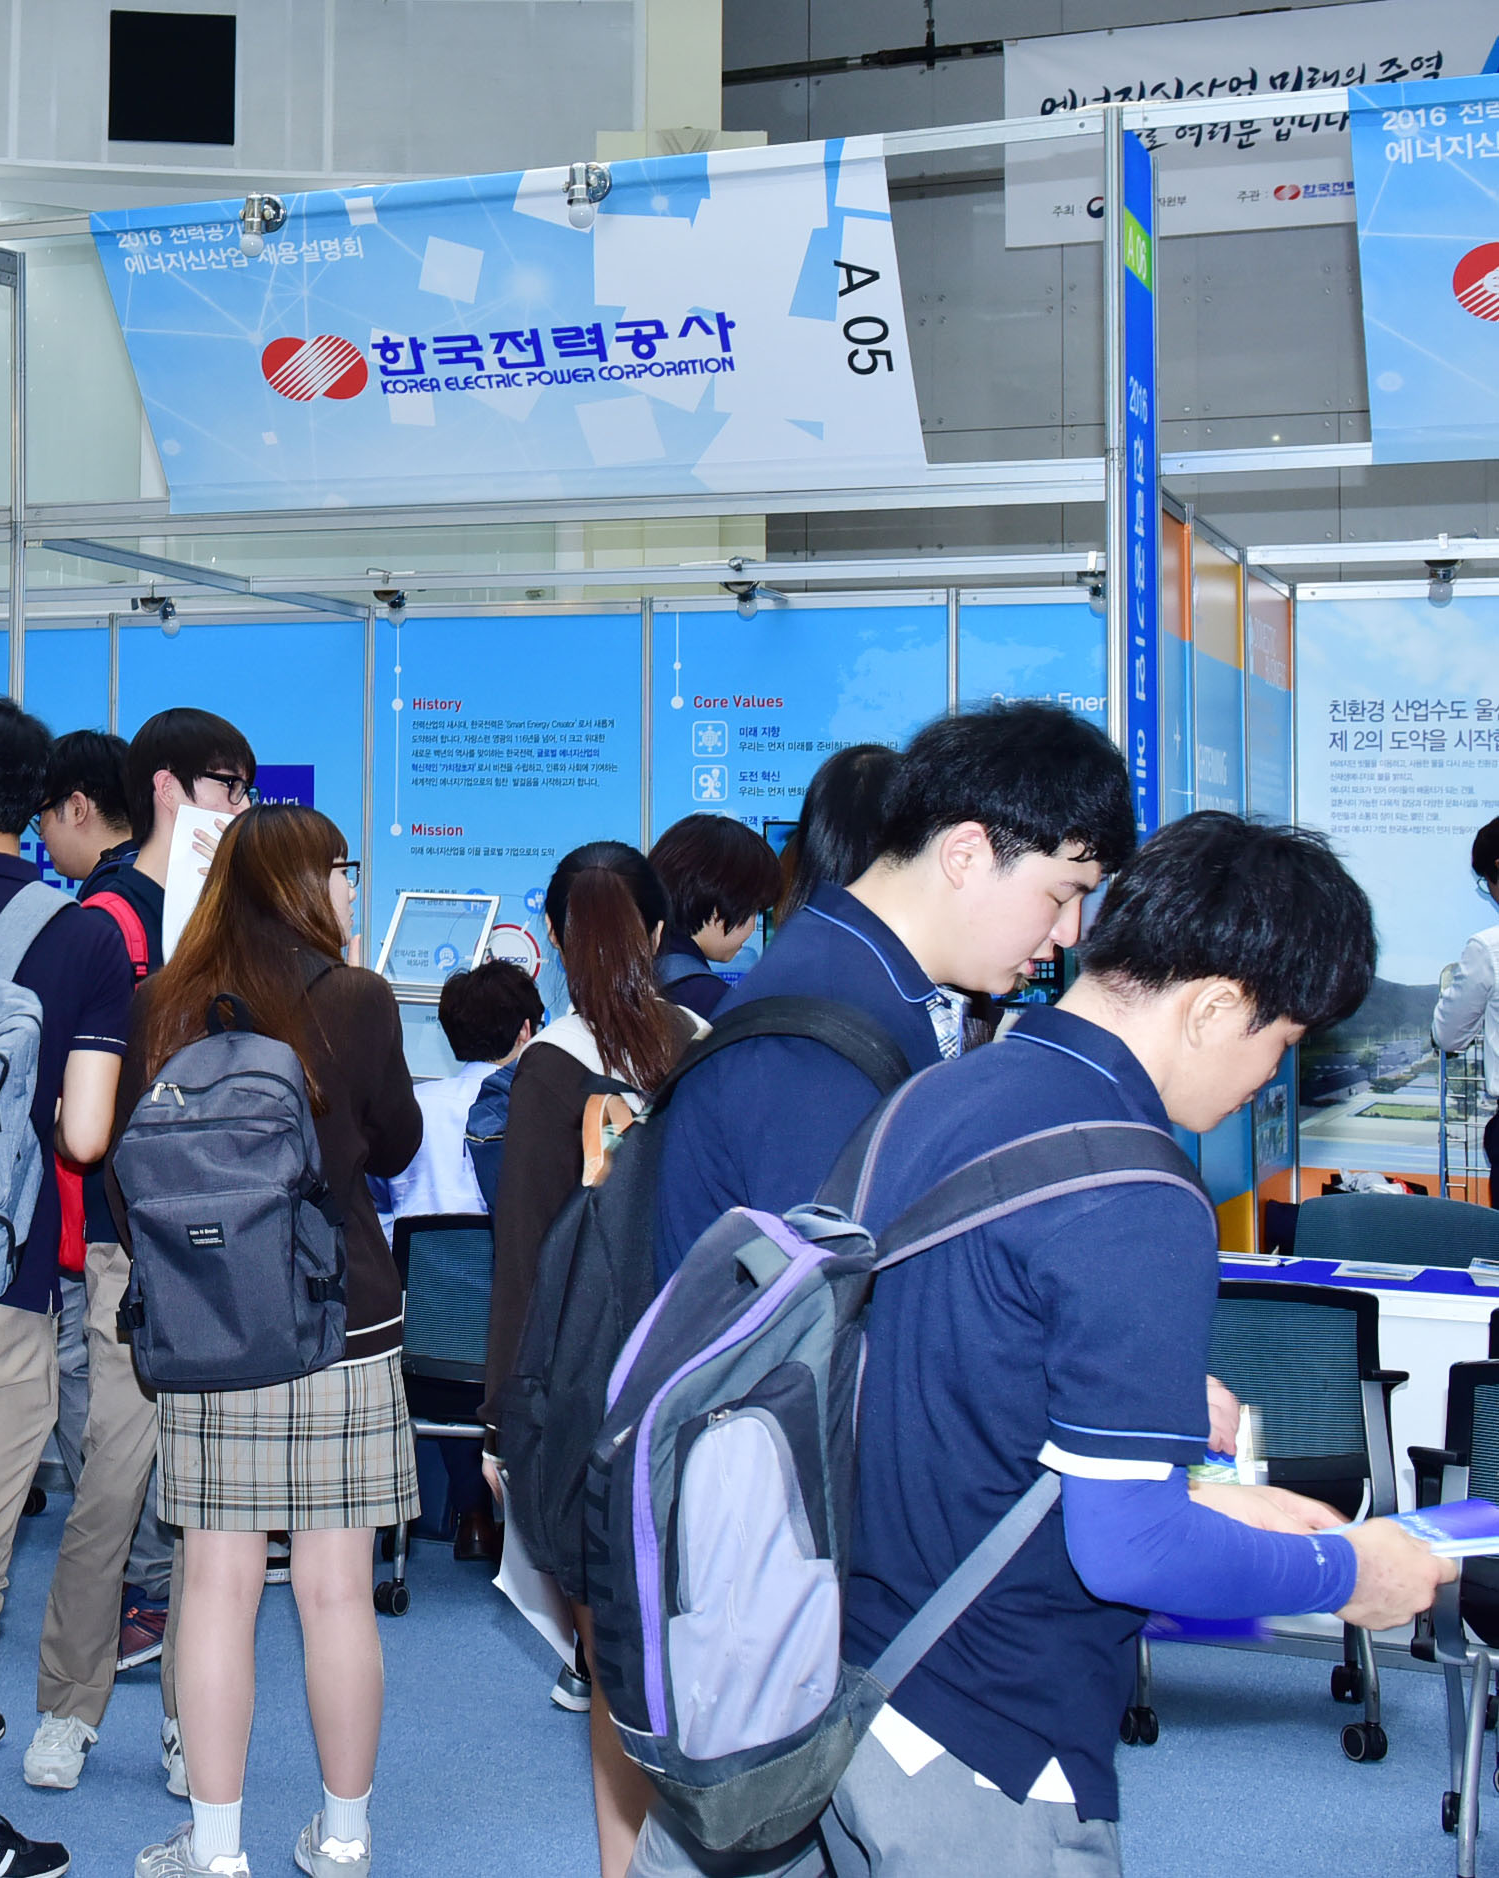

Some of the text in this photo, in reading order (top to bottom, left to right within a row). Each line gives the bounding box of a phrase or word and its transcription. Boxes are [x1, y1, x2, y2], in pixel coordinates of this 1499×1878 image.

[1269, 62, 1365, 91] 미래의
[1375, 50, 1443, 83] 주역
[1382, 106, 1447, 131] 2016
[116, 221, 245, 249] 2016 전력공기
[124, 236, 364, 275] 에너지신산업 채용설명회
[1127, 225, 1147, 280] A 06
[833, 259, 895, 377] A 05
[371, 310, 737, 377] 한국전력공사
[380, 355, 737, 396] KOREA ELECTRIC POWER CORPORATION
[1129, 375, 1148, 424] 2016
[412, 698, 462, 712] History
[693, 695, 784, 709] Core Values
[1328, 698, 1499, 723] 친환경 산업수도 울
[527, 720, 550, 730] Energy
[739, 726, 781, 738] 미래 지향
[739, 741, 764, 752] 우리는
[768, 741, 785, 752] 먼저
[788, 741, 814, 752] 미래를
[1328, 729, 1348, 752] 제
[1353, 729, 1383, 752] 2의
[1389, 729, 1448, 752] 도약을
[739, 771, 781, 782] 도전 혁신
[739, 786, 764, 797] 우리는
[768, 786, 785, 797] 먼저
[411, 824, 463, 836] Mission
[410, 847, 424, 856] 미래
